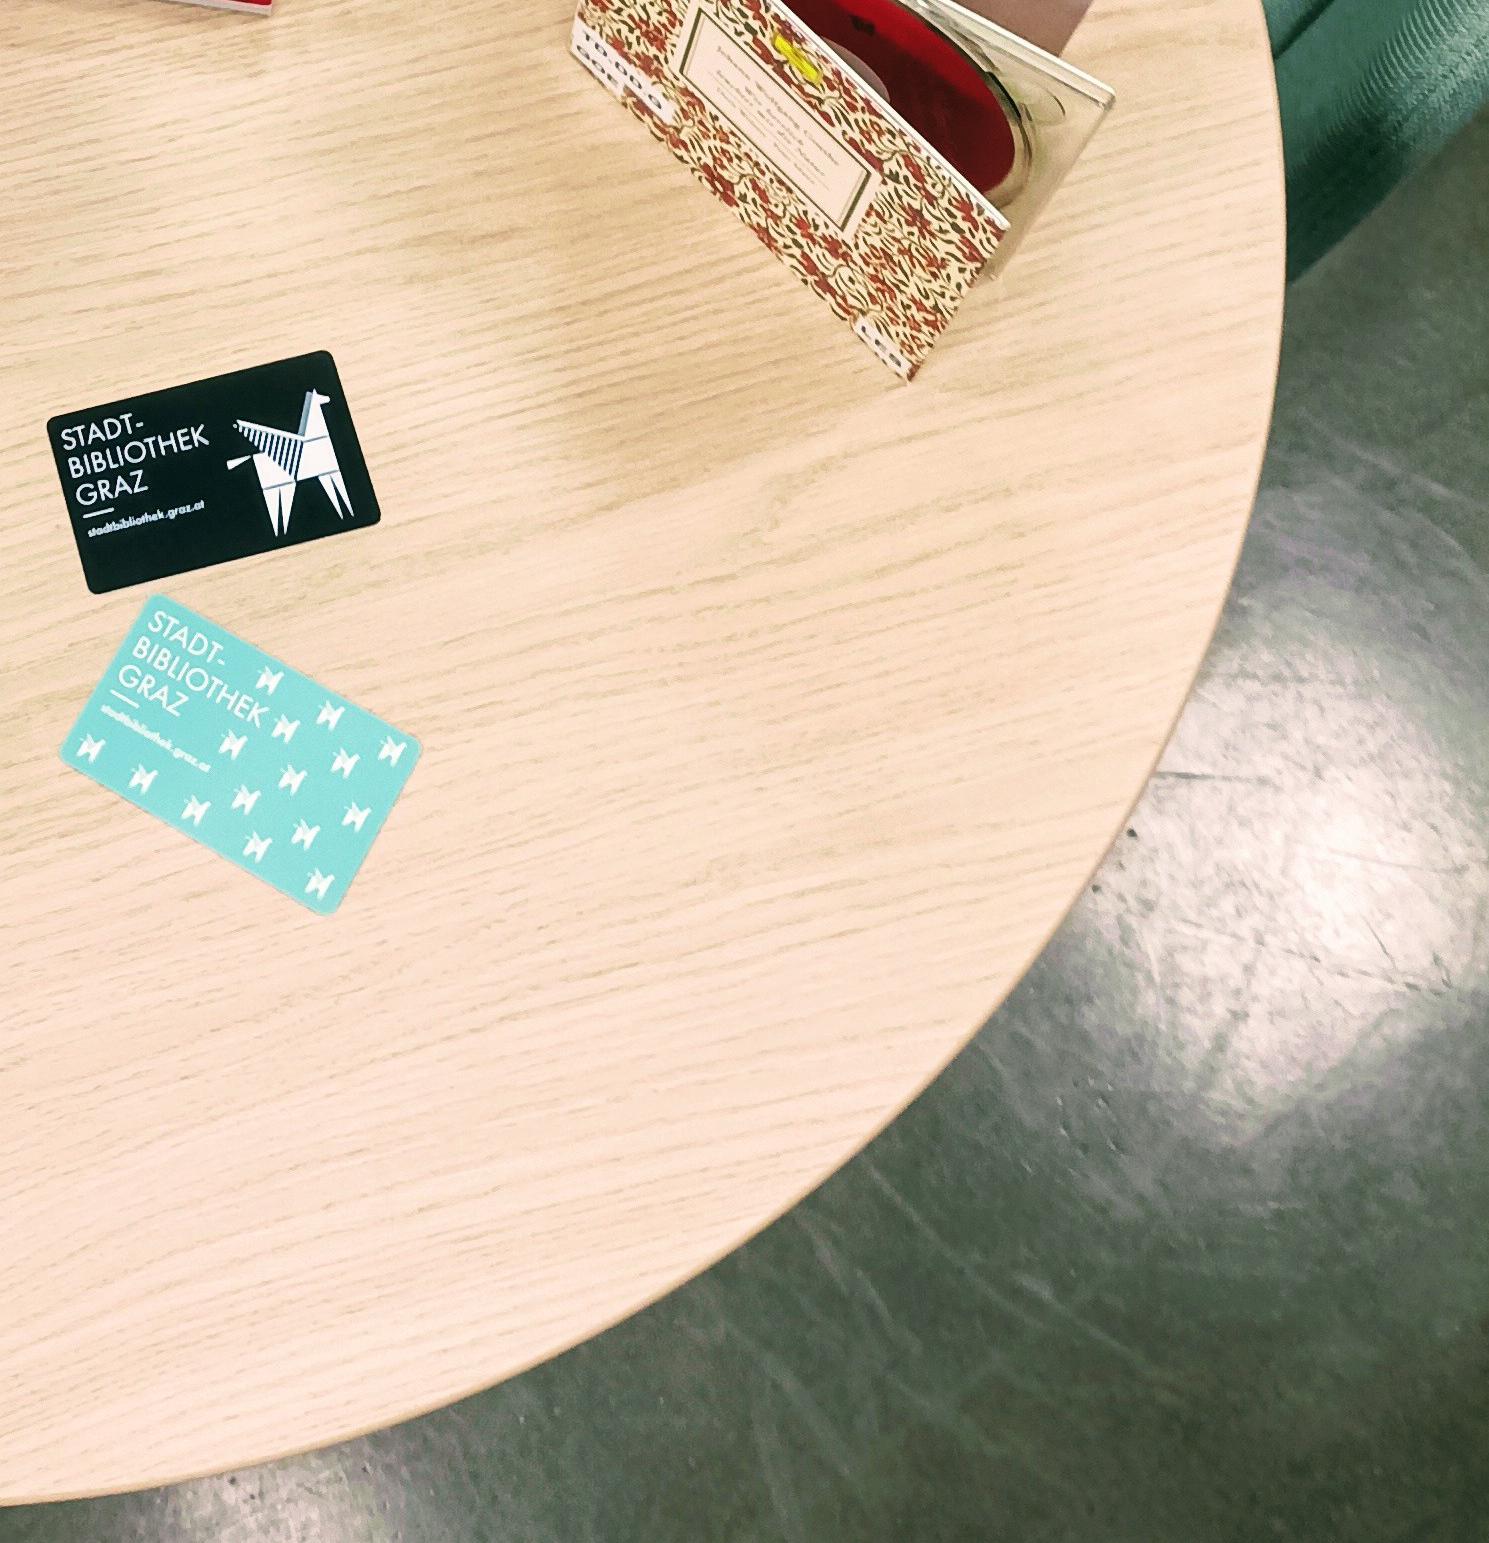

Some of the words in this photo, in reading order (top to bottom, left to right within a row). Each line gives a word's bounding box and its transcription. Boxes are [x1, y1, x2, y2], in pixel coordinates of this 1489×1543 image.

[60, 412, 143, 450] STADT-
[67, 423, 209, 478] BIBLIOTHEK
[75, 469, 148, 505] GRAZ
[87, 499, 204, 537] stadtbibliothek.graz.at
[147, 610, 225, 665] STADT-
[118, 664, 189, 716] GRAZ
[132, 636, 269, 728] BIBLIOTHEK
